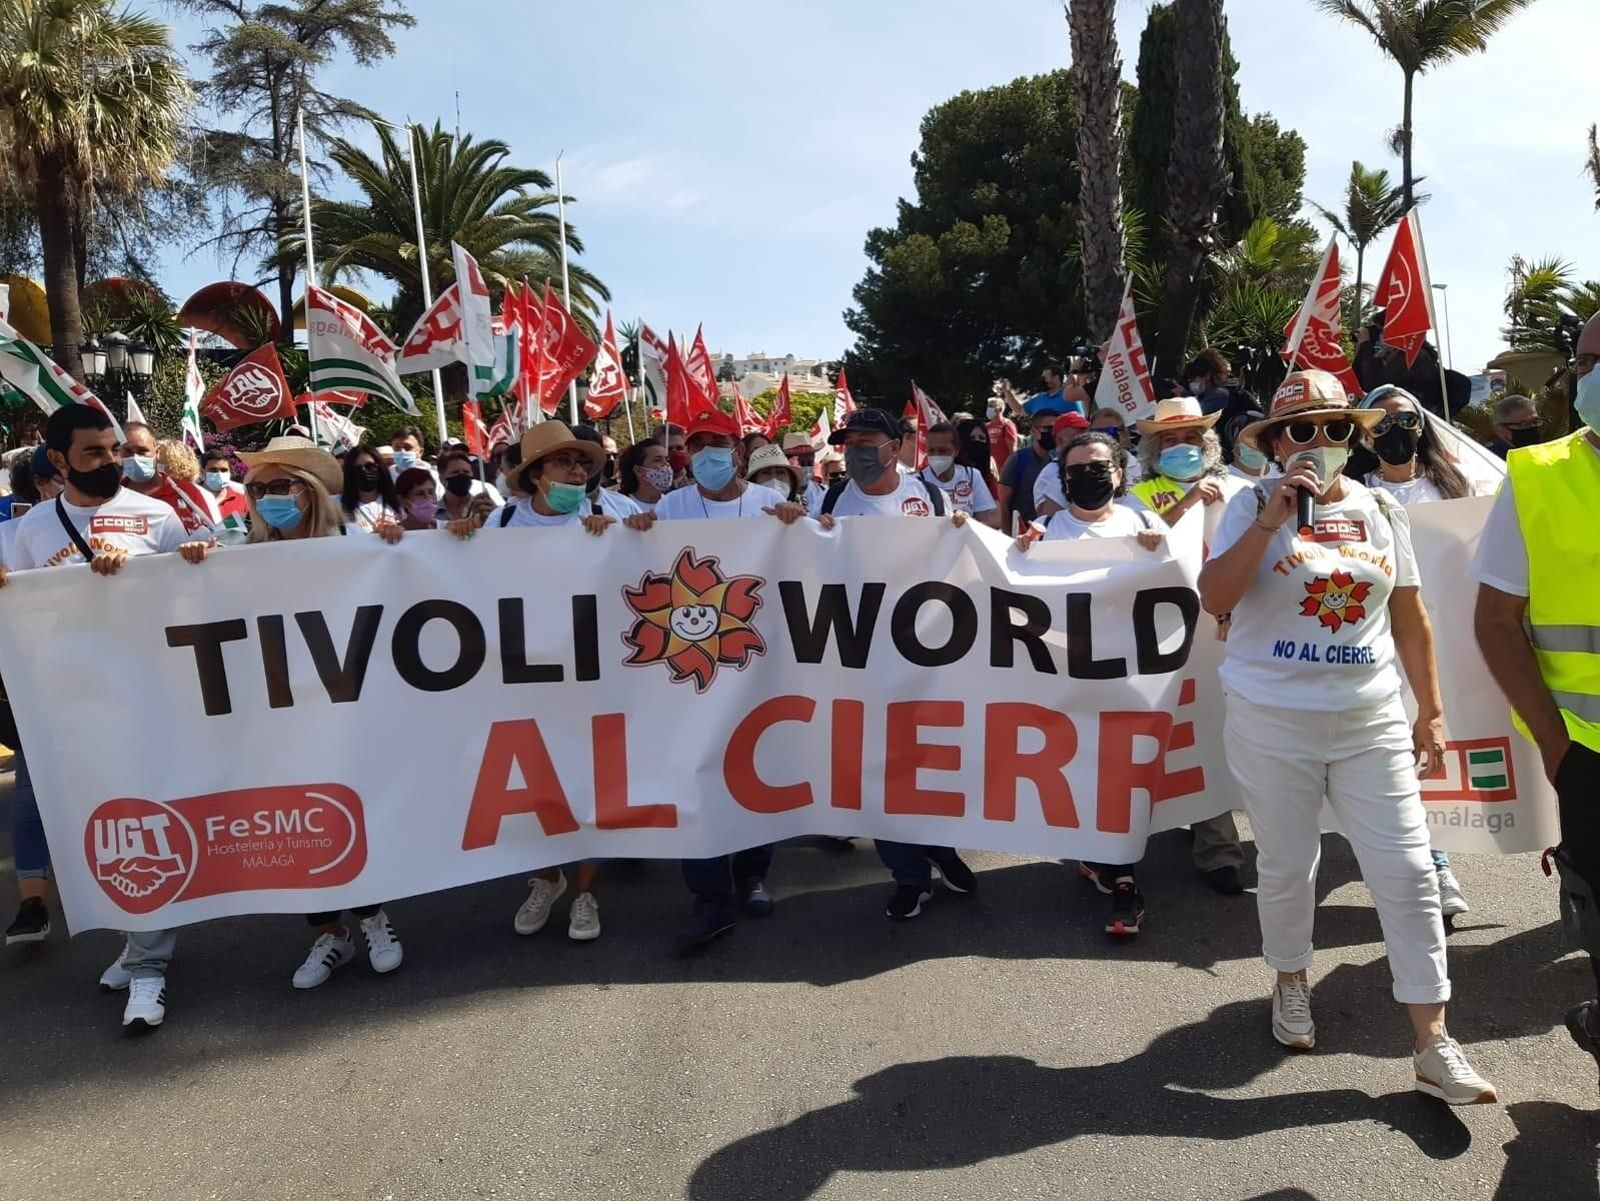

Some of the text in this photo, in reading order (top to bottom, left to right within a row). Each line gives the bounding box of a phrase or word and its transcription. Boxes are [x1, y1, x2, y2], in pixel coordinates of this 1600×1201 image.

[1107, 352, 1137, 412] Málaga
[904, 501, 926, 512] UGT
[1151, 491, 1179, 508] UGT
[165, 580, 1200, 716] TIVOLI WORLD
[1273, 640, 1376, 665] NO AL CIERRE
[461, 712, 677, 851] AL
[206, 808, 325, 841] FeSMC
[1426, 806, 1515, 834] málaga
[94, 813, 176, 861] UGT
[276, 842, 283, 855] y
[286, 836, 333, 851] Turismo
